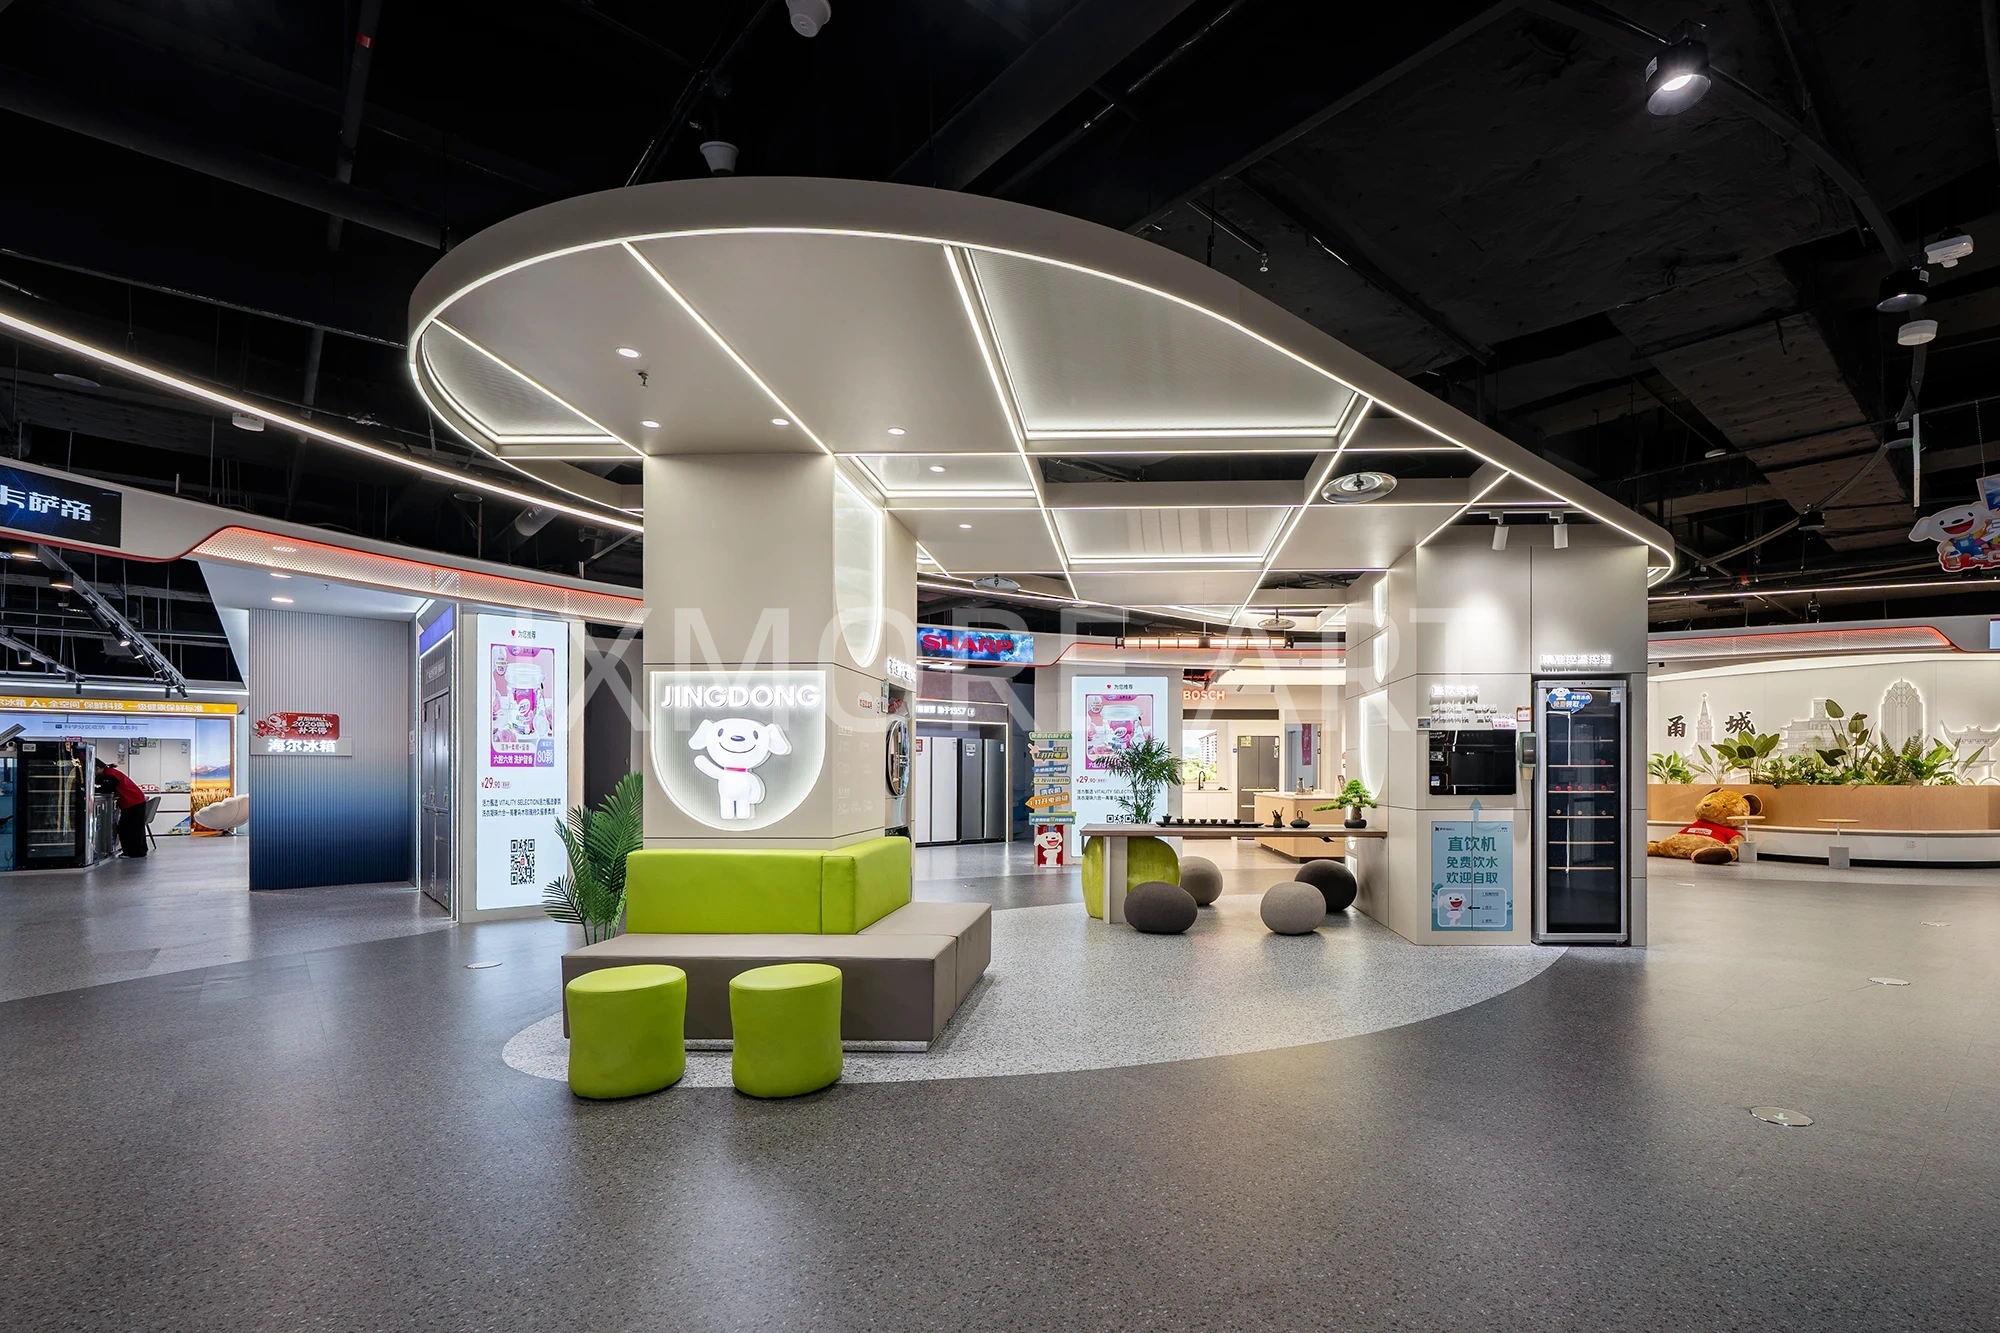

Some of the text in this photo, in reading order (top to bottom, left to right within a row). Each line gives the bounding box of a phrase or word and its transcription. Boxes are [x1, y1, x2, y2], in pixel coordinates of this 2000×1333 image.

[517, 630, 537, 640] 为您推荐
[922, 634, 1014, 654] SHARP
[661, 684, 821, 708] JINGDONG
[1183, 690, 1226, 701] BOSCH
[1667, 711, 1757, 738] 甬 城
[298, 728, 328, 736] 补不停
[267, 738, 337, 753] 海尔冰箱
[1041, 787, 1062, 796] 洗衣机
[1447, 836, 1497, 852] 直饮机
[1446, 856, 1499, 869] 免费饮水
[1446, 871, 1499, 884] 欢迎自取
